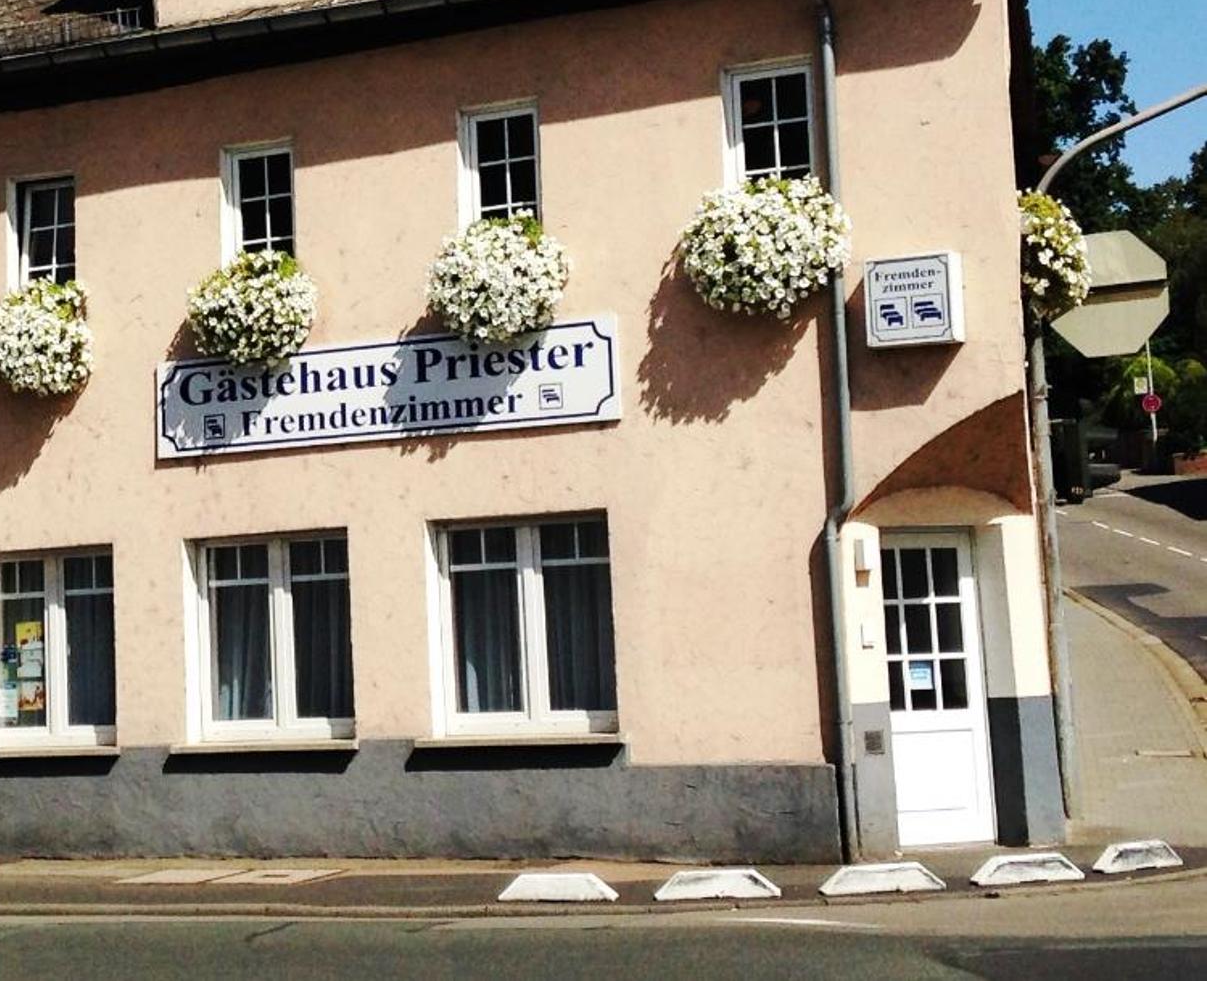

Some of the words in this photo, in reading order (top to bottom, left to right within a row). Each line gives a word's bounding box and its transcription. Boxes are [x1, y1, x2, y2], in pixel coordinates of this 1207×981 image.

[882, 280, 934, 293] zimmer
[179, 362, 398, 406] Gästehaus
[413, 341, 594, 384] Priester
[241, 394, 523, 437] Fremdenzimmer
